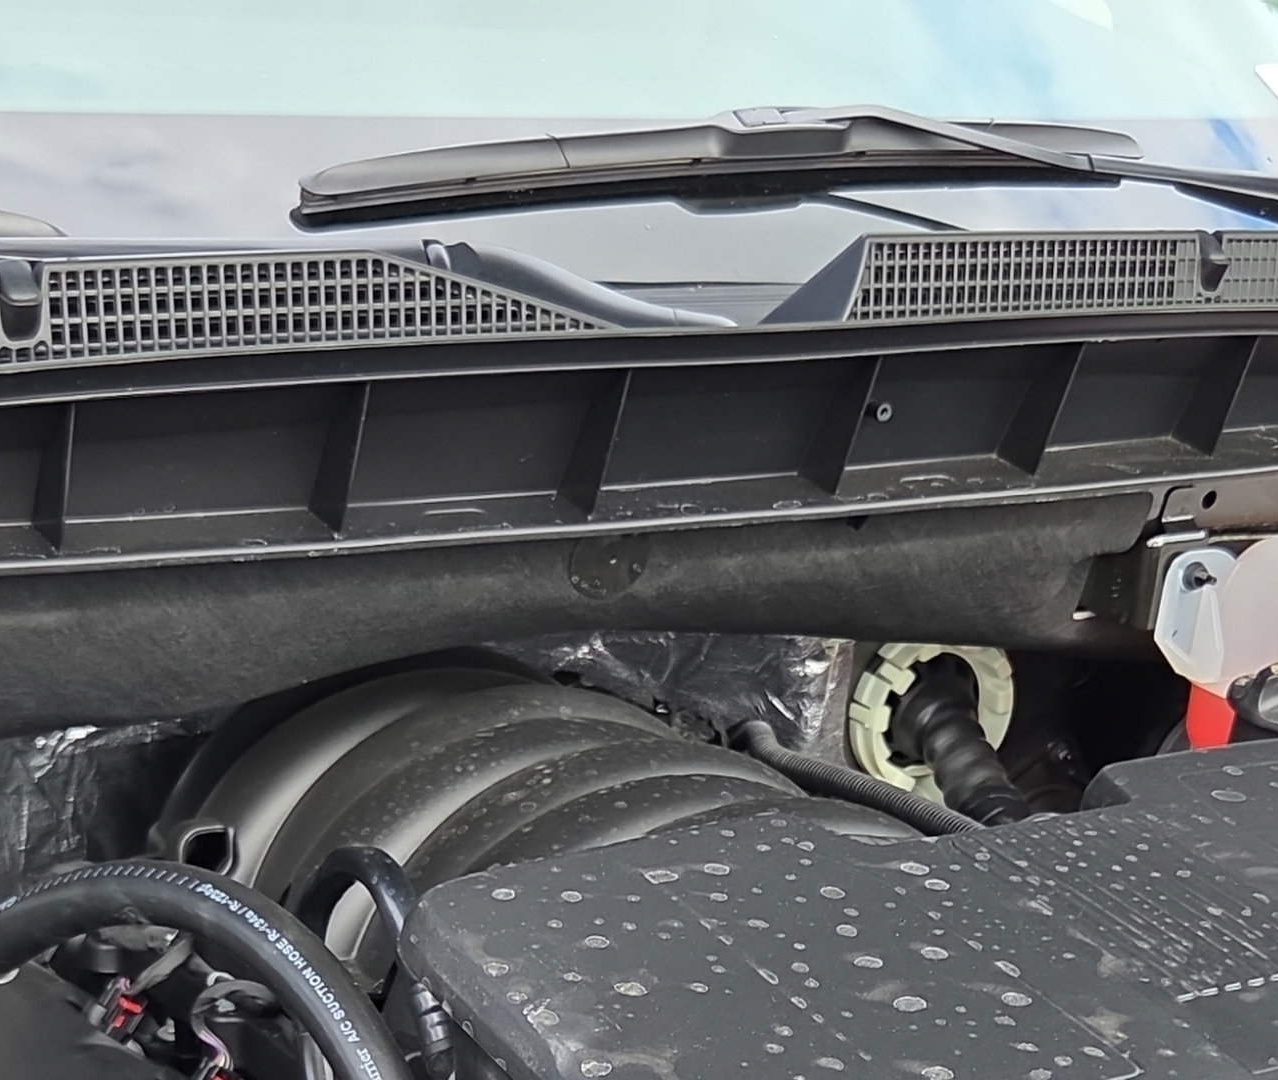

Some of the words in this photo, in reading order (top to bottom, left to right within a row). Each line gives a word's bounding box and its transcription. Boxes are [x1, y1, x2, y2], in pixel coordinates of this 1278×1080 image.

[244, 911, 280, 942] R-134a
[275, 938, 308, 970] HOSE
[301, 966, 345, 1021] SUCTION
[340, 1021, 361, 1043] A/C
